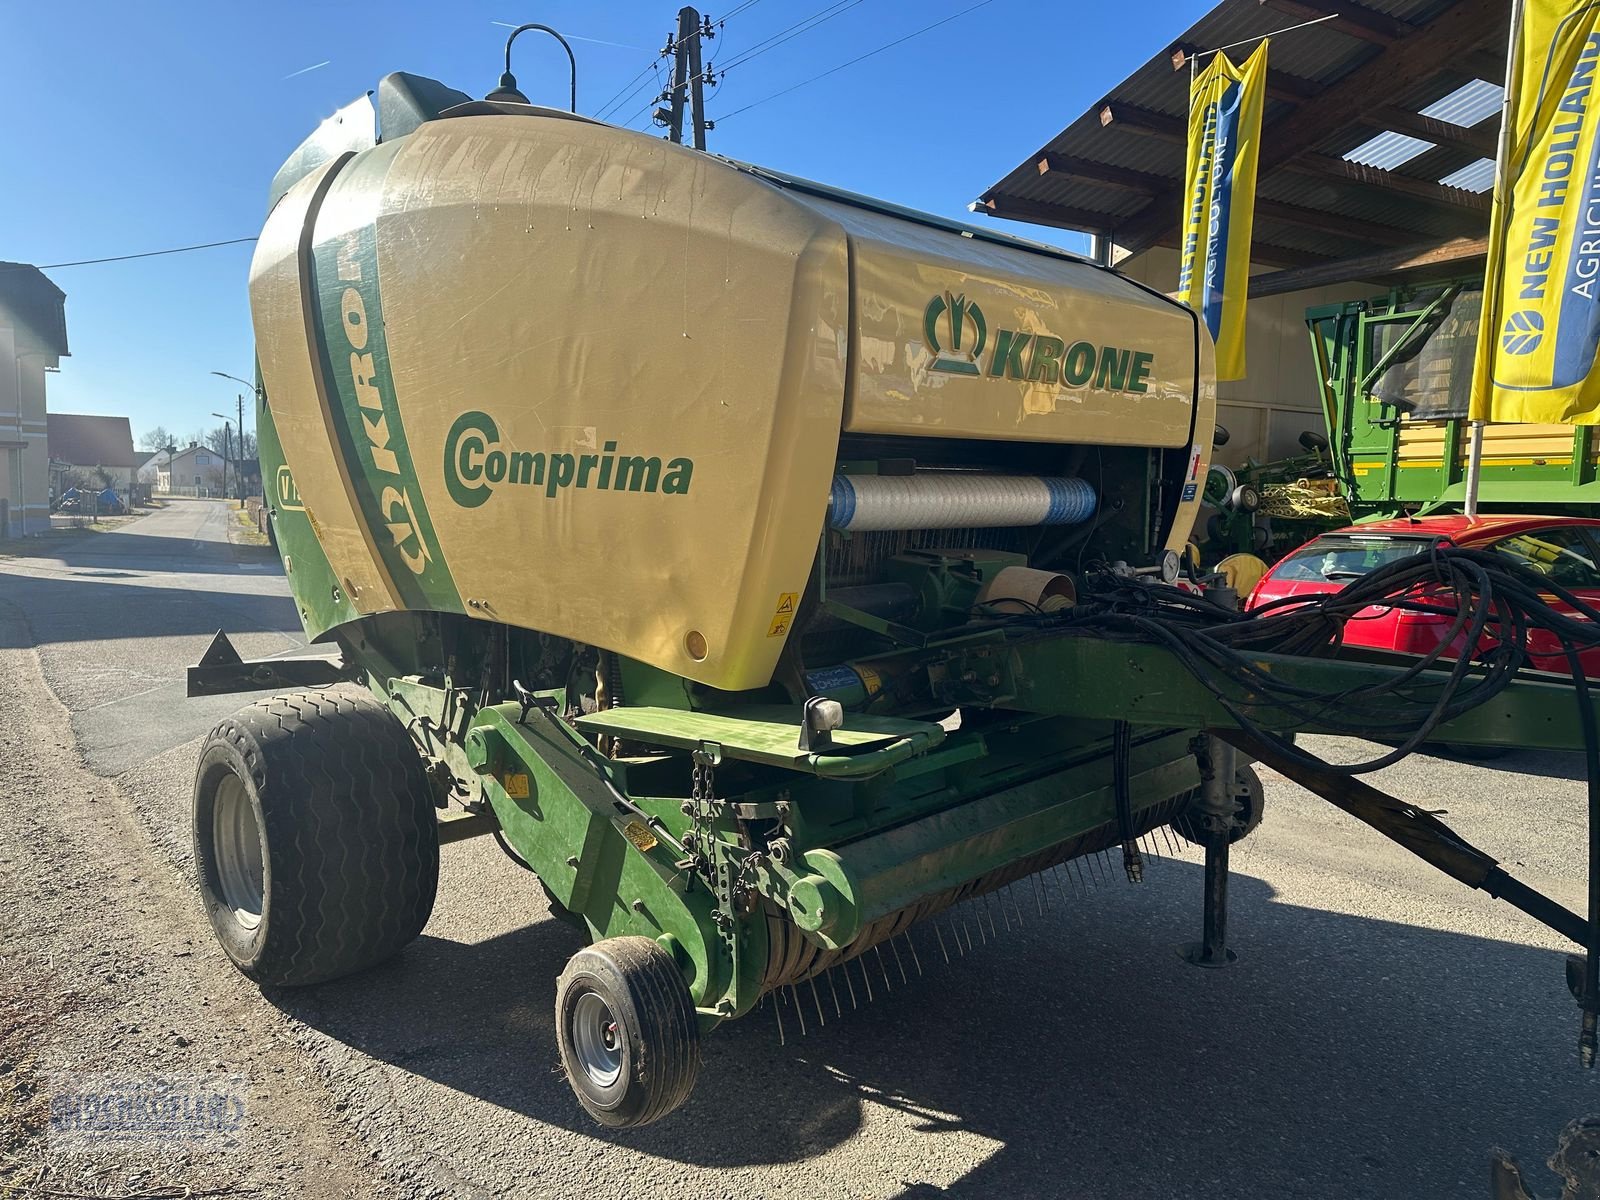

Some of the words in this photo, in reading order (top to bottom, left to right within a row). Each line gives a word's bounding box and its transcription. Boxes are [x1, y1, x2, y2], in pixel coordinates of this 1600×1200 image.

[1537, 32, 1600, 207] HOLLAND
[1207, 136, 1227, 289] AGRICULTURE
[1178, 233, 1198, 292] NEW
[1519, 217, 1560, 299] NEW
[987, 328, 1154, 393] KRONE
[444, 411, 694, 508] Comprima
